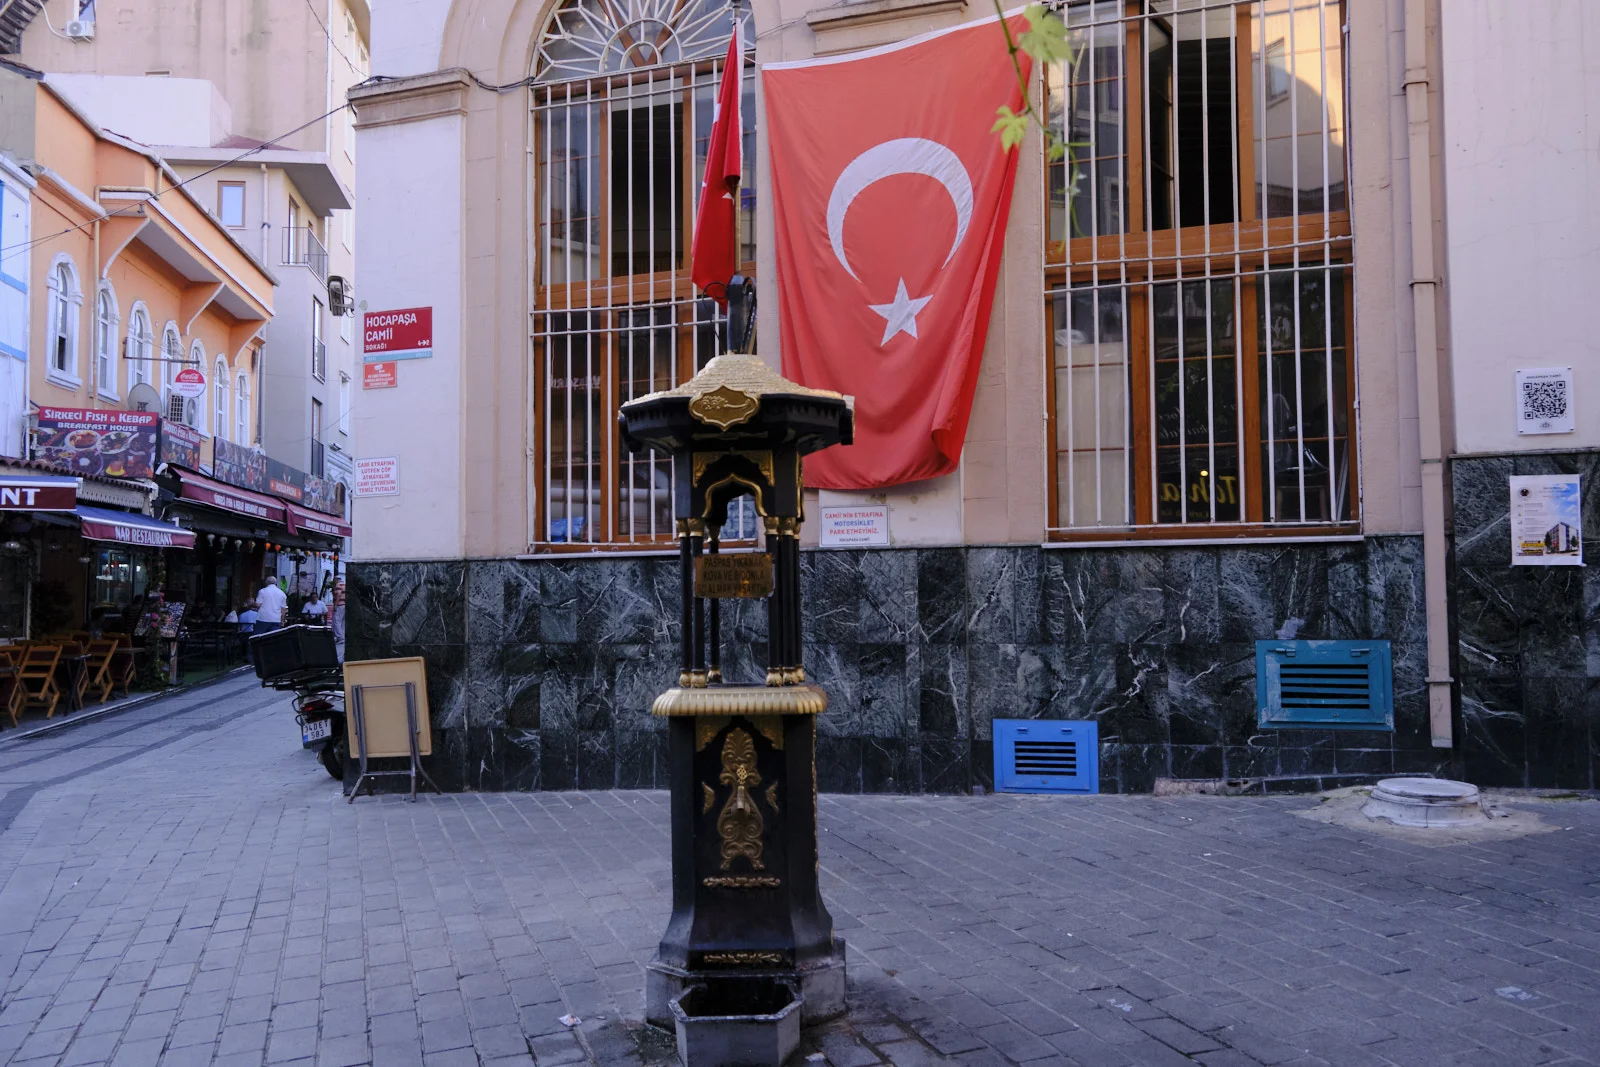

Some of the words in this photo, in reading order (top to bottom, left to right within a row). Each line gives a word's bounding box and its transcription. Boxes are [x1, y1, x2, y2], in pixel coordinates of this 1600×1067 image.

[366, 313, 417, 327] HOCAPAŞA
[366, 328, 393, 342] CAMİİ
[365, 343, 387, 351] SOKAĞI
[85, 411, 108, 422] FISH
[118, 413, 153, 424] KEBAP
[57, 421, 108, 431] BREAKFAST
[0, 488, 41, 506] NT
[834, 519, 875, 527] MOTORSİKLET
[114, 526, 131, 541] NAR
[132, 527, 173, 546] RESTAURANT
[703, 570, 722, 581] KOVA
[723, 570, 733, 581] VE
